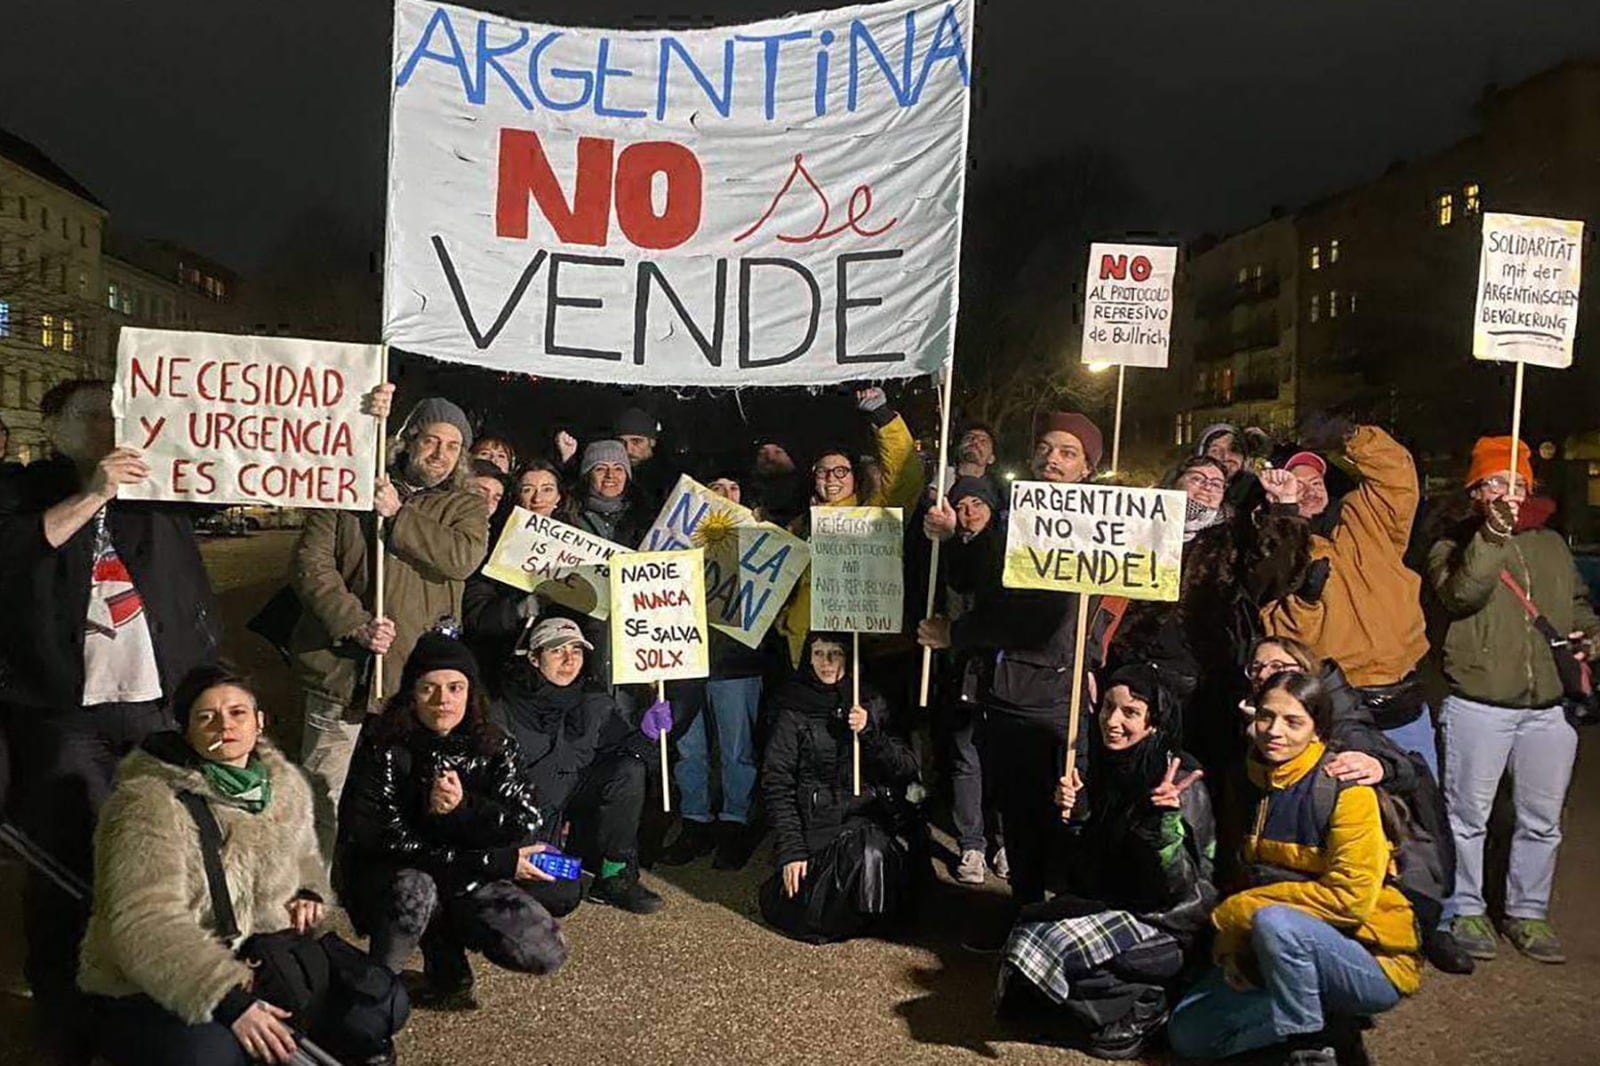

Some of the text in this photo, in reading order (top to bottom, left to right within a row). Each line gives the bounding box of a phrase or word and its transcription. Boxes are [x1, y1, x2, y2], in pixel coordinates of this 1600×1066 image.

[496, 128, 703, 249] NO
[1099, 254, 1152, 282] NO
[1502, 263, 1562, 285] mit der
[431, 236, 905, 368] VENDE
[1089, 285, 1170, 302] AL PROTOCOLO
[1089, 326, 1167, 348] de Bullrich
[131, 356, 344, 408] NECESIDAD
[173, 459, 358, 503] ES COMER
[525, 514, 627, 561] ARGENTIN
[1035, 516, 1125, 546] NO SE
[521, 556, 577, 588] SALE
[531, 541, 610, 578] IS NOT FO
[740, 532, 792, 584] LA
[1028, 546, 1159, 589] VENDE!
[633, 590, 691, 612] NUNCA
[625, 618, 702, 644] SE SALVA
[824, 616, 839, 631] NO
[845, 617, 859, 630] AL
[635, 649, 683, 671] SOLX
